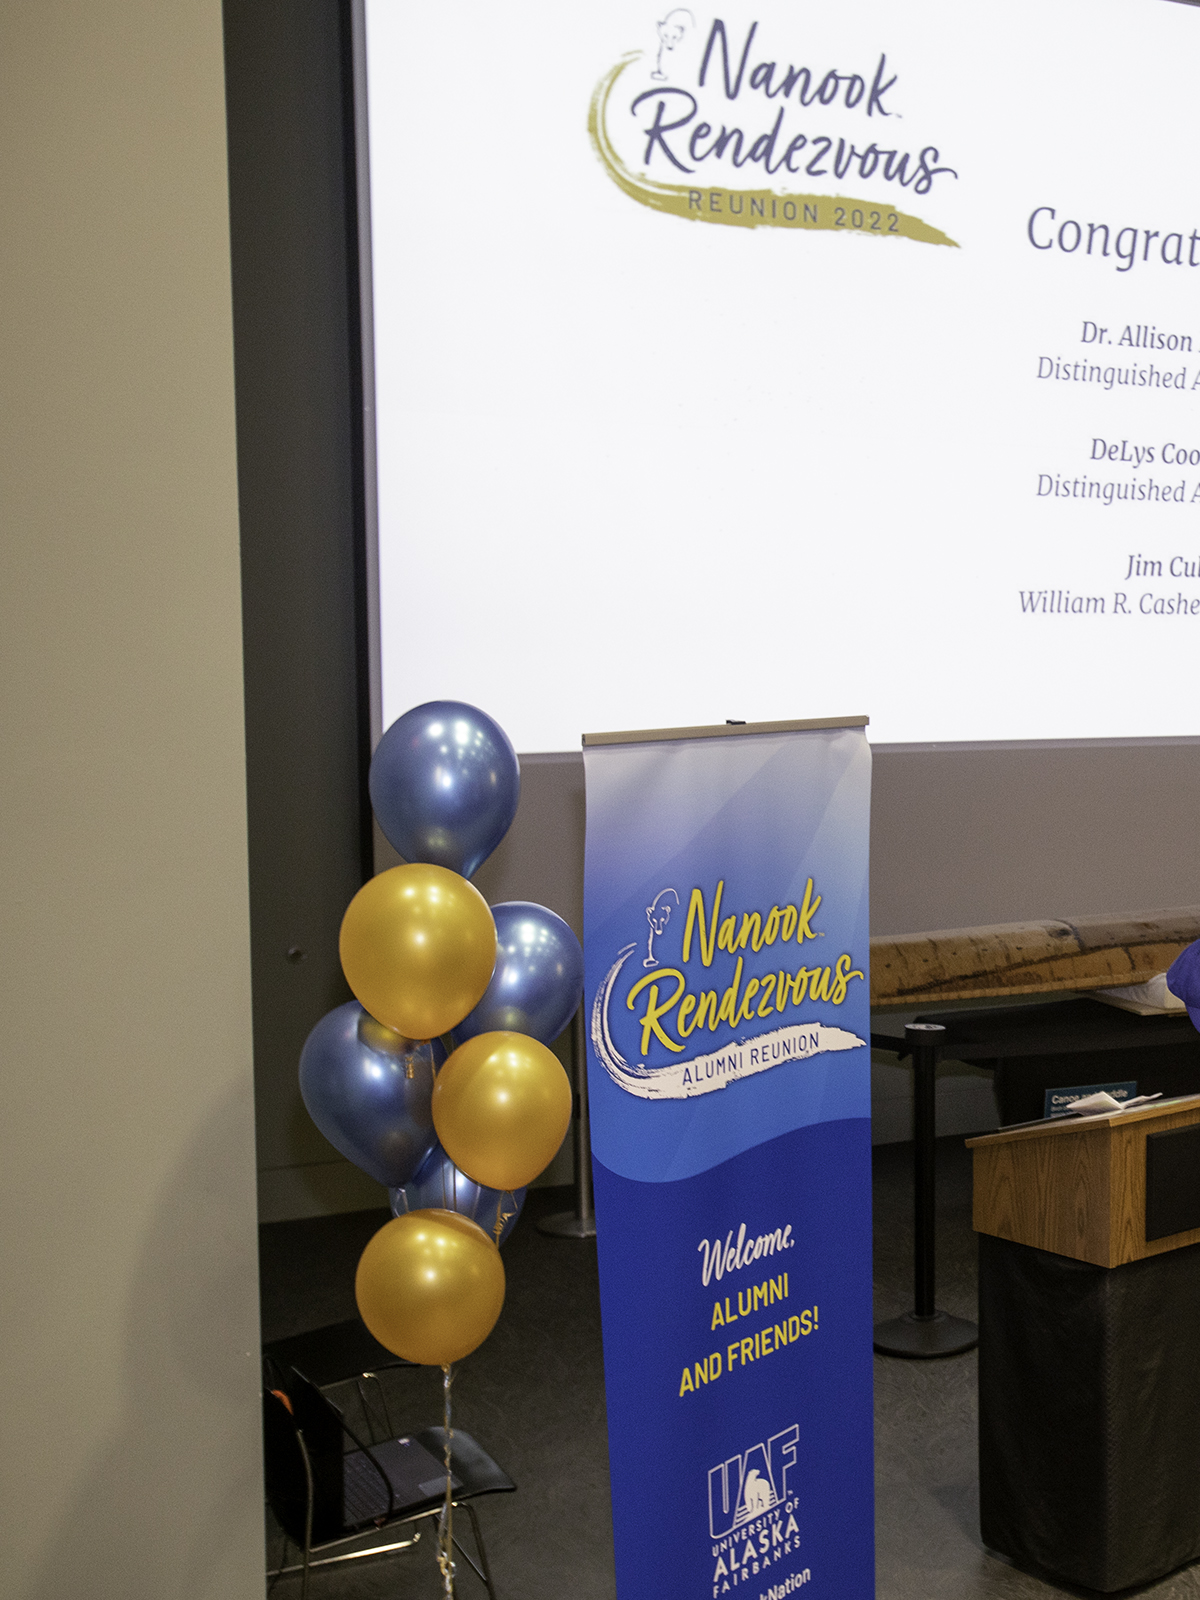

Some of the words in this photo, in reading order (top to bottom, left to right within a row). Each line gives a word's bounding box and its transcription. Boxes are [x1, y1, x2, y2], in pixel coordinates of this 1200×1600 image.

[699, 19, 898, 117] Nanook
[631, 87, 958, 195] Rendezvous
[688, 190, 819, 224] REUNION
[834, 207, 900, 232] 2022
[1080, 321, 1112, 345] Dr.
[1117, 325, 1193, 352] Allison
[1036, 356, 1187, 390] Distinguished
[1090, 438, 1155, 468] DeLys
[1036, 474, 1186, 505] Distinguished
[1125, 554, 1163, 580] Jim
[1019, 590, 1105, 614] William
[1112, 592, 1132, 615] R.
[682, 877, 822, 967] Nanook
[626, 954, 864, 1055] Rendezvous
[682, 1051, 744, 1086] ALUMNI
[750, 1031, 820, 1066] REUNION
[1051, 1094, 1080, 1104] Canoe
[711, 1272, 789, 1331] ALUMNI
[679, 1352, 723, 1397] AND
[727, 1305, 819, 1372] FRIENDS!
[708, 1424, 799, 1539] UAF
[712, 1508, 781, 1557] UNIVERSITY
[785, 1497, 800, 1513] OF
[713, 1514, 800, 1582] ALASKA
[713, 1536, 801, 1599] FAIRBANKS
